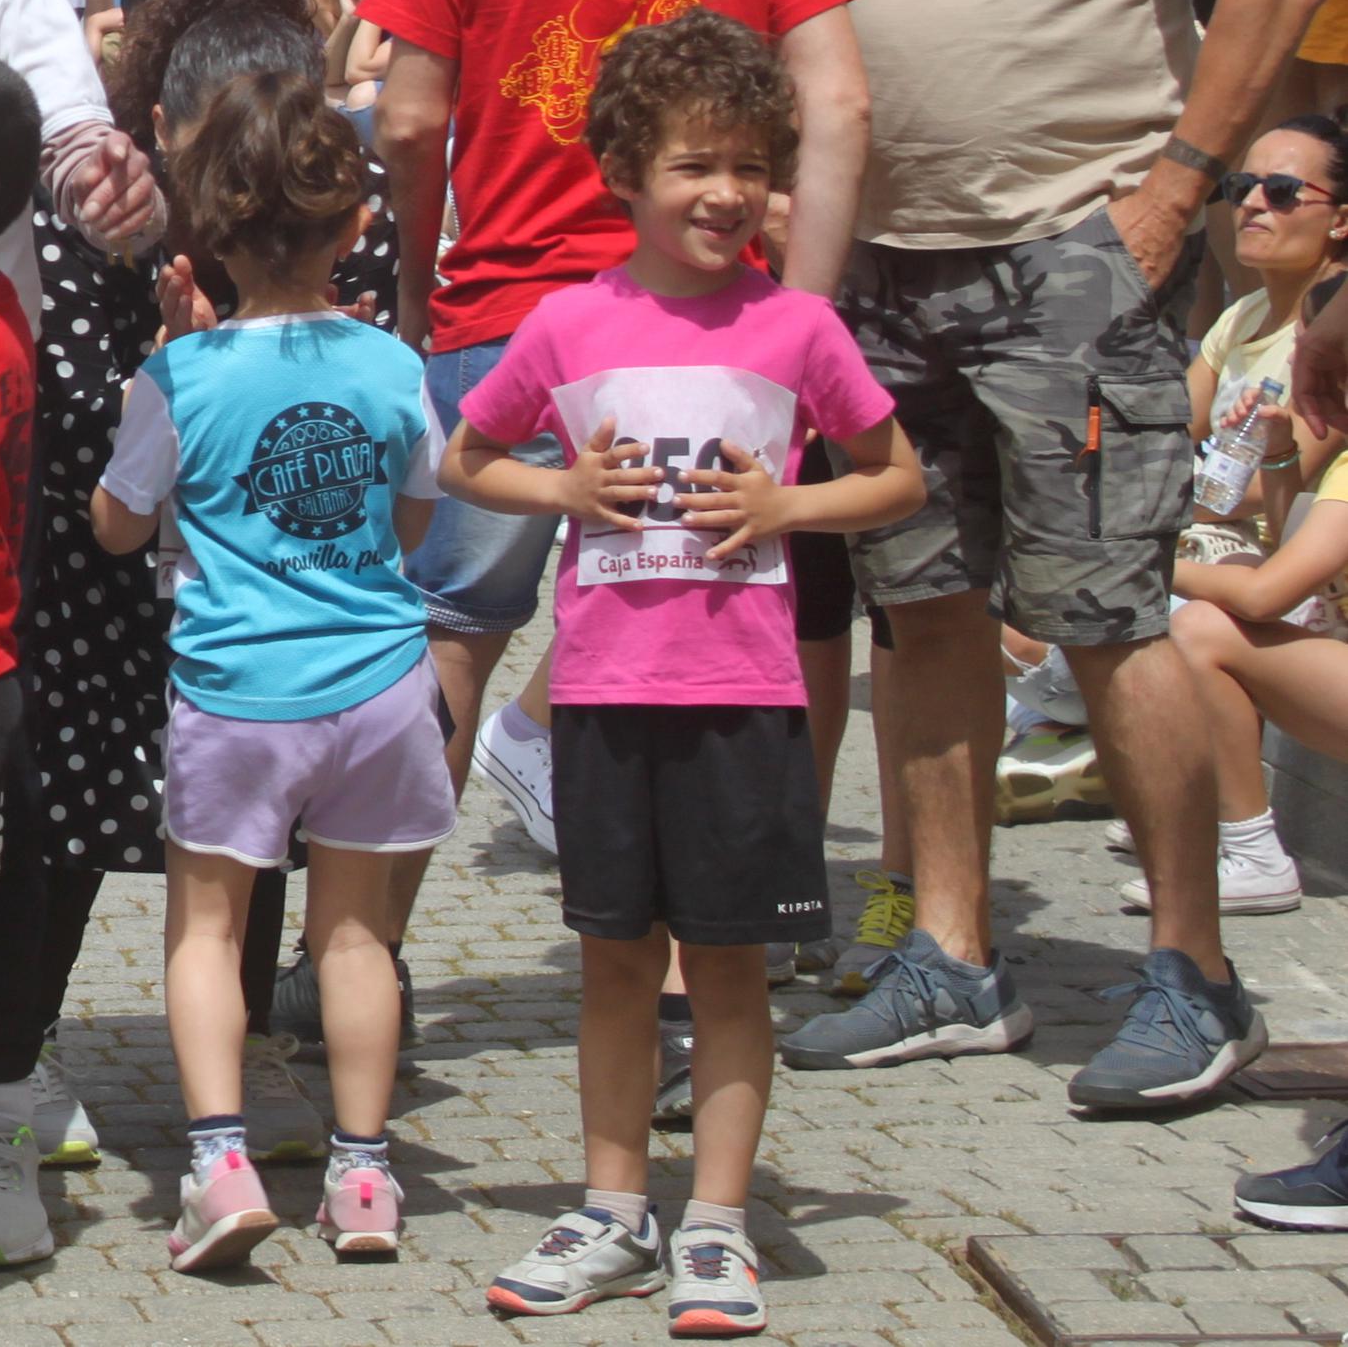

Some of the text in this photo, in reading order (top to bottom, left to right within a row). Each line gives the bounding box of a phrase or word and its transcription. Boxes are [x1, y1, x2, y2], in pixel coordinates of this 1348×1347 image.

[290, 423, 330, 447] 1998
[255, 442, 371, 497] CAFÉ PLAZA
[261, 543, 350, 575] aravilla
[597, 551, 704, 577] Caja España
[777, 900, 823, 914] KIPSTA
